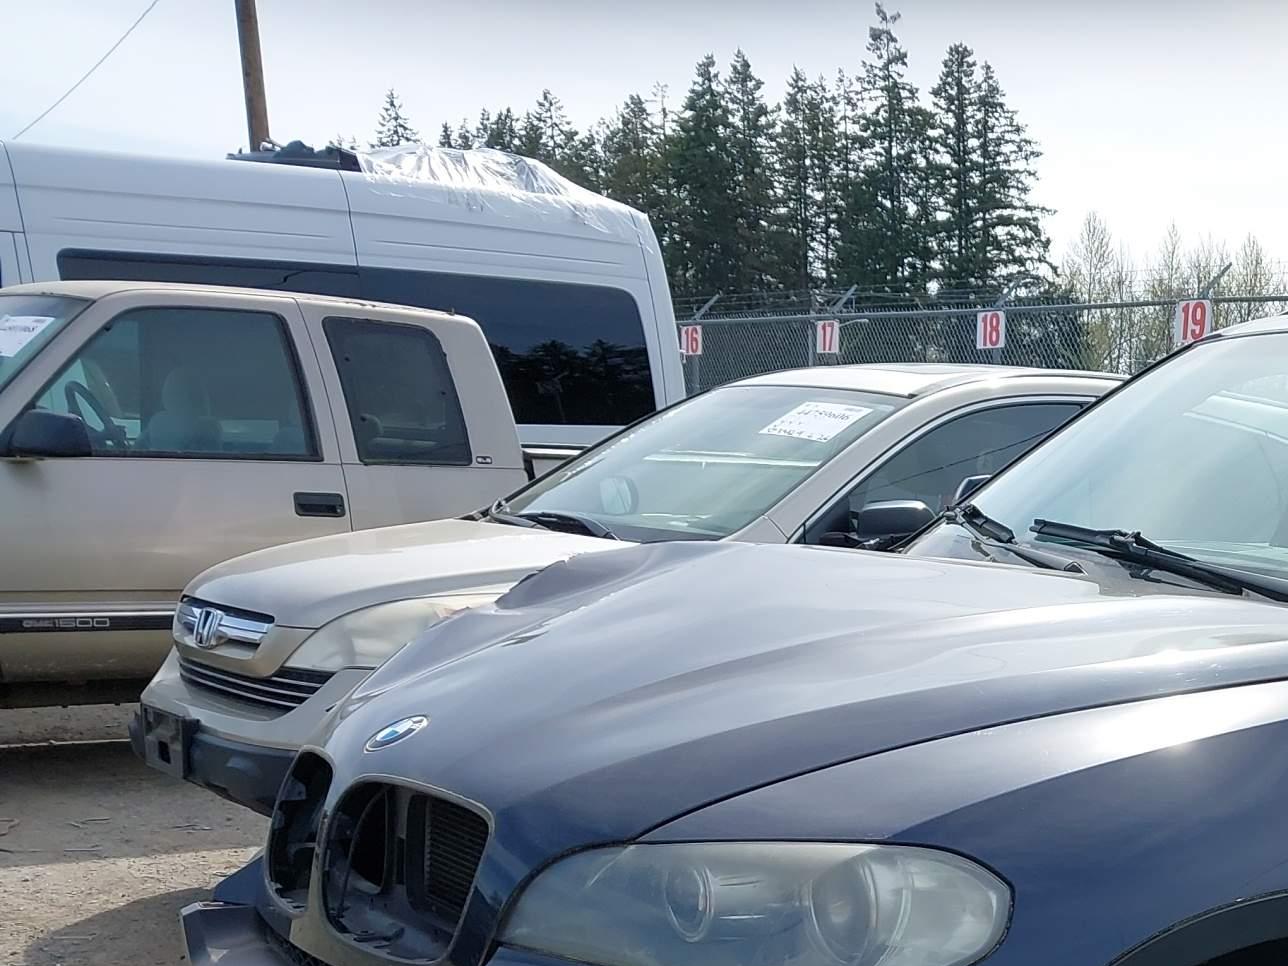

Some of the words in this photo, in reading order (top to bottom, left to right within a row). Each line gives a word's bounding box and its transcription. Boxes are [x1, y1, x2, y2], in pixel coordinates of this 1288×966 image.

[821, 322, 835, 352] 17
[981, 312, 1000, 346] 18
[1181, 301, 1207, 342] 19
[684, 326, 699, 353] 16
